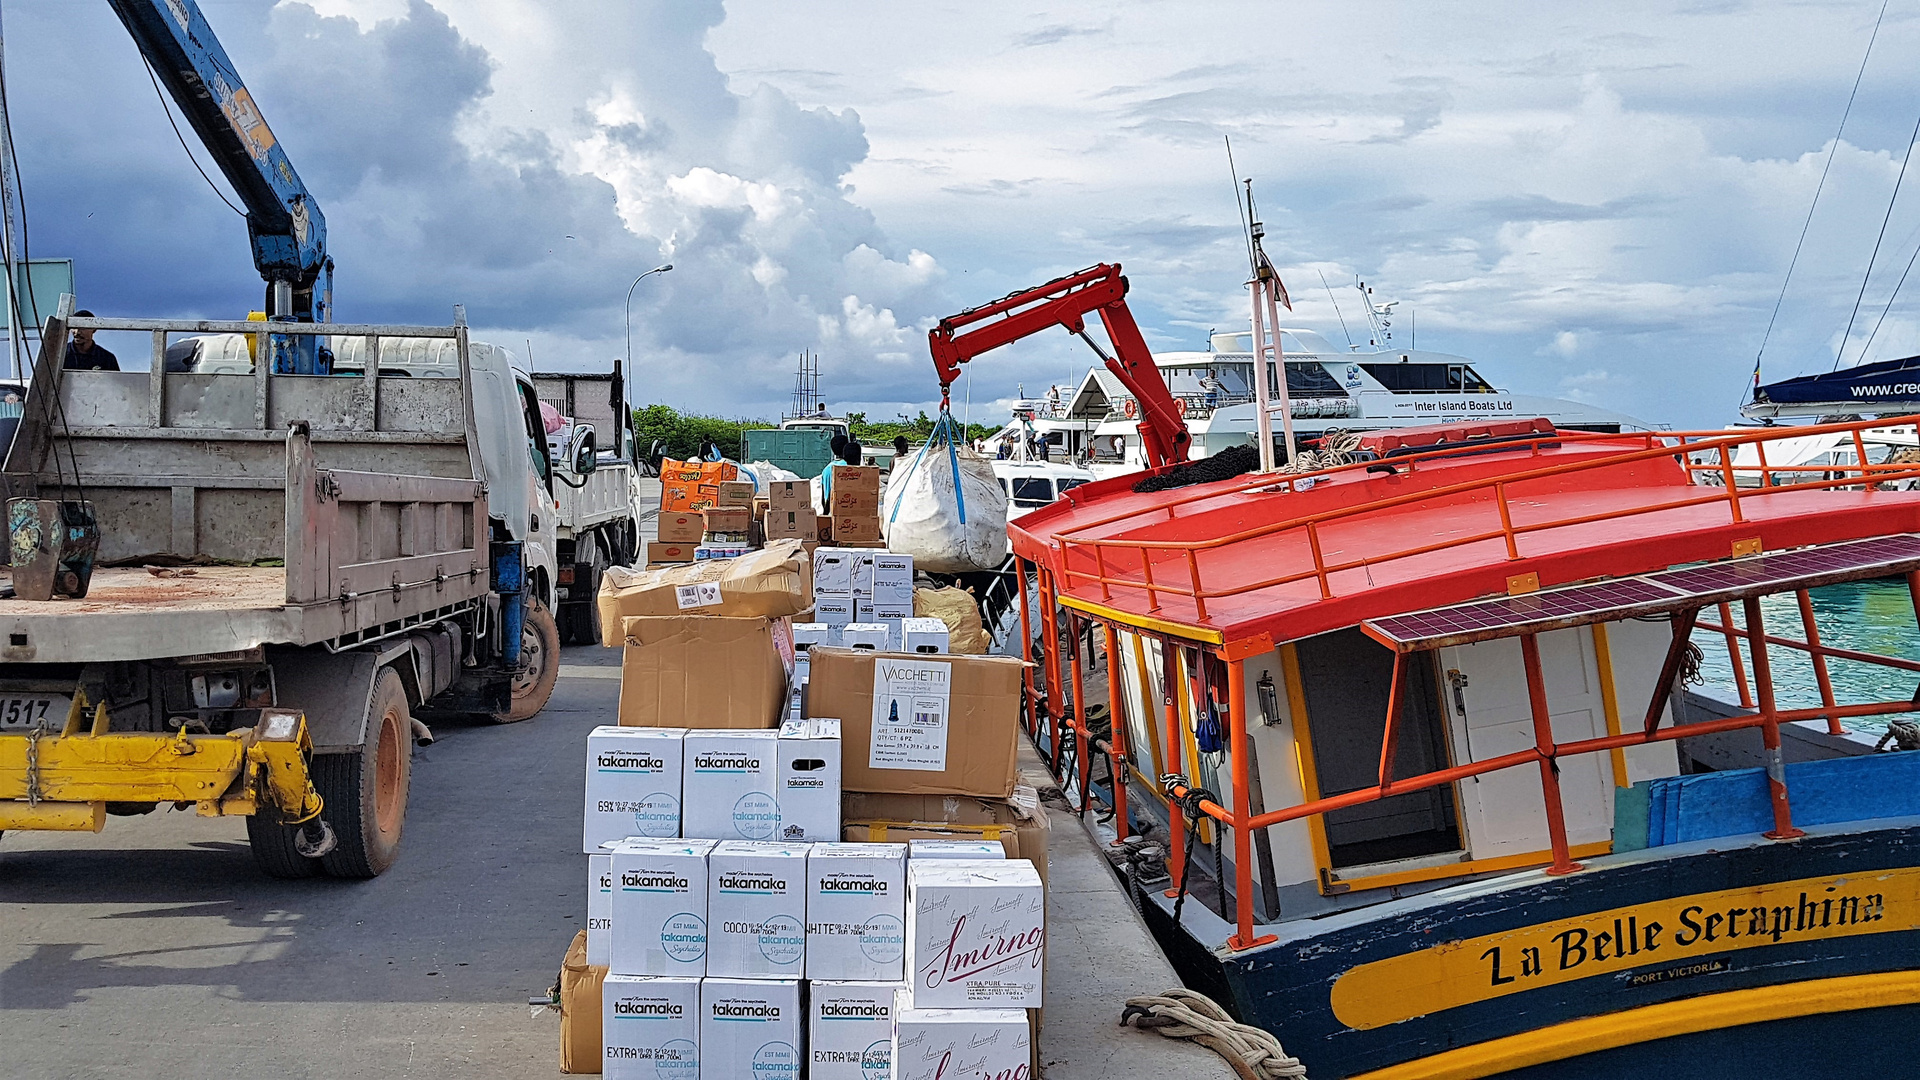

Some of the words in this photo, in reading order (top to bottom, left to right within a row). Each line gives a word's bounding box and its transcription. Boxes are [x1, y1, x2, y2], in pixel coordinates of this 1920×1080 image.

[1850, 383, 1920, 397] www.cre
[1414, 401, 1436, 411] Inter
[1439, 401, 1466, 411] Island
[1469, 401, 1495, 410] Boats
[1498, 401, 1512, 410] Ltd
[882, 665, 945, 682] VACCHETTI
[598, 755, 663, 768] takamaka
[695, 756, 760, 768] takamaka
[787, 779, 824, 787] takamaka
[598, 801, 614, 812] 69%
[733, 812, 781, 821] takamaka
[622, 874, 688, 887] takamaka
[719, 876, 786, 889] takamaka
[820, 878, 887, 890] takamaka
[946, 905, 980, 926] Smioff
[724, 922, 747, 933] COCO
[1479, 946, 1543, 986] La
[1551, 916, 1663, 970] Belle
[1675, 887, 1884, 946] Seraphina
[1633, 972, 1663, 985] PORT
[1668, 961, 1722, 978] VICTORIA
[614, 1002, 682, 1014] takamaka
[712, 1004, 779, 1016] takamaka
[821, 1004, 888, 1015] takamaka
[607, 1047, 637, 1058] EXTRA
[815, 1051, 844, 1062] EXTRA
